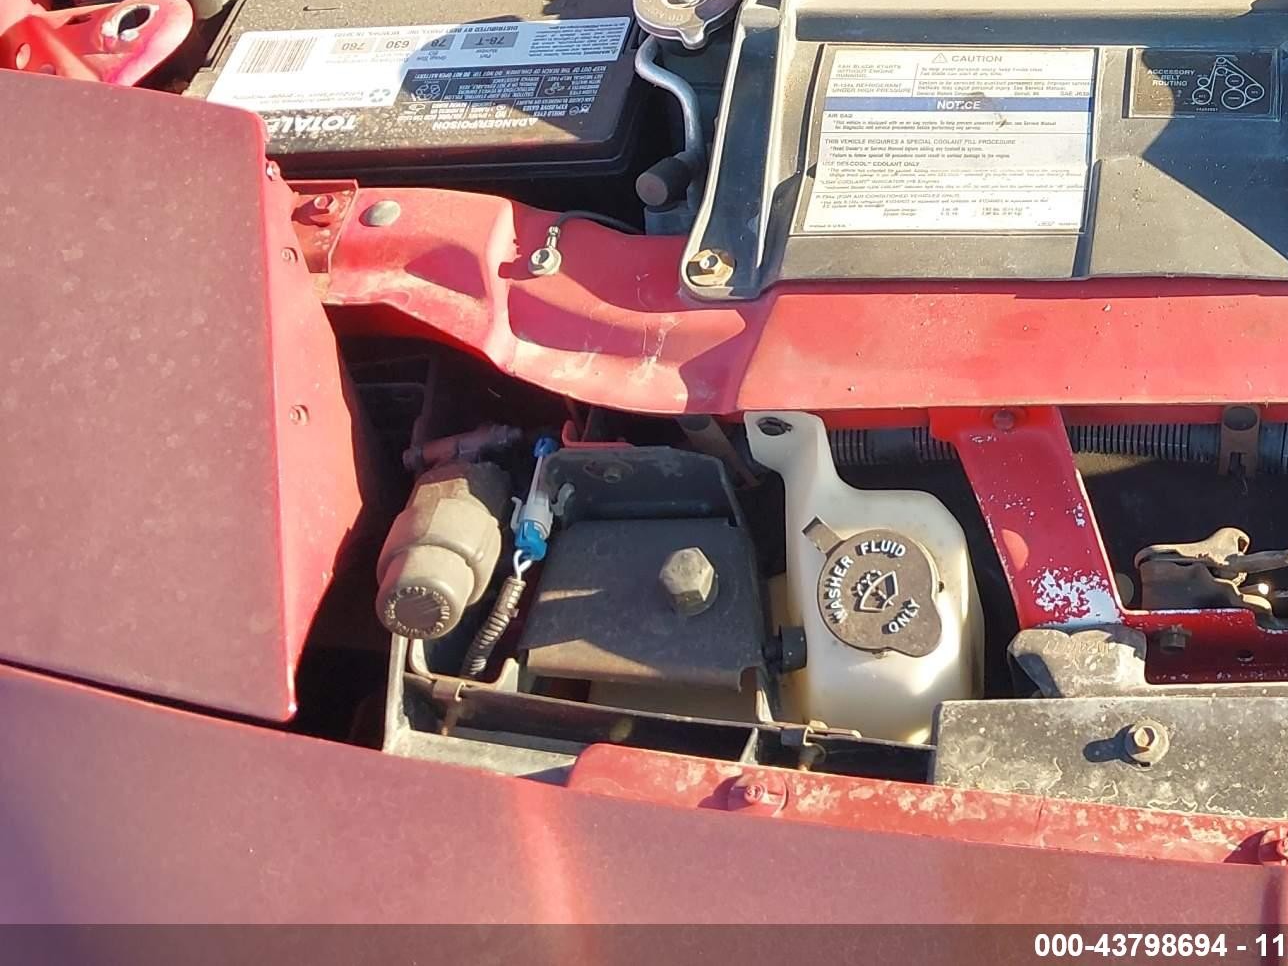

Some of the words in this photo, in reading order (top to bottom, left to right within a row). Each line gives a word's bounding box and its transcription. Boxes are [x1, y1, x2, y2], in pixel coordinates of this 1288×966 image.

[474, 25, 519, 33] DISTRIBUTED
[386, 40, 410, 50] 630
[430, 39, 447, 47] 78
[475, 36, 505, 46] 78-T
[951, 55, 1003, 63] CAUTION
[936, 100, 982, 110] NOTICE
[828, 554, 855, 624] WASHER
[860, 539, 906, 557] FLUID
[888, 597, 921, 634] ONLY
